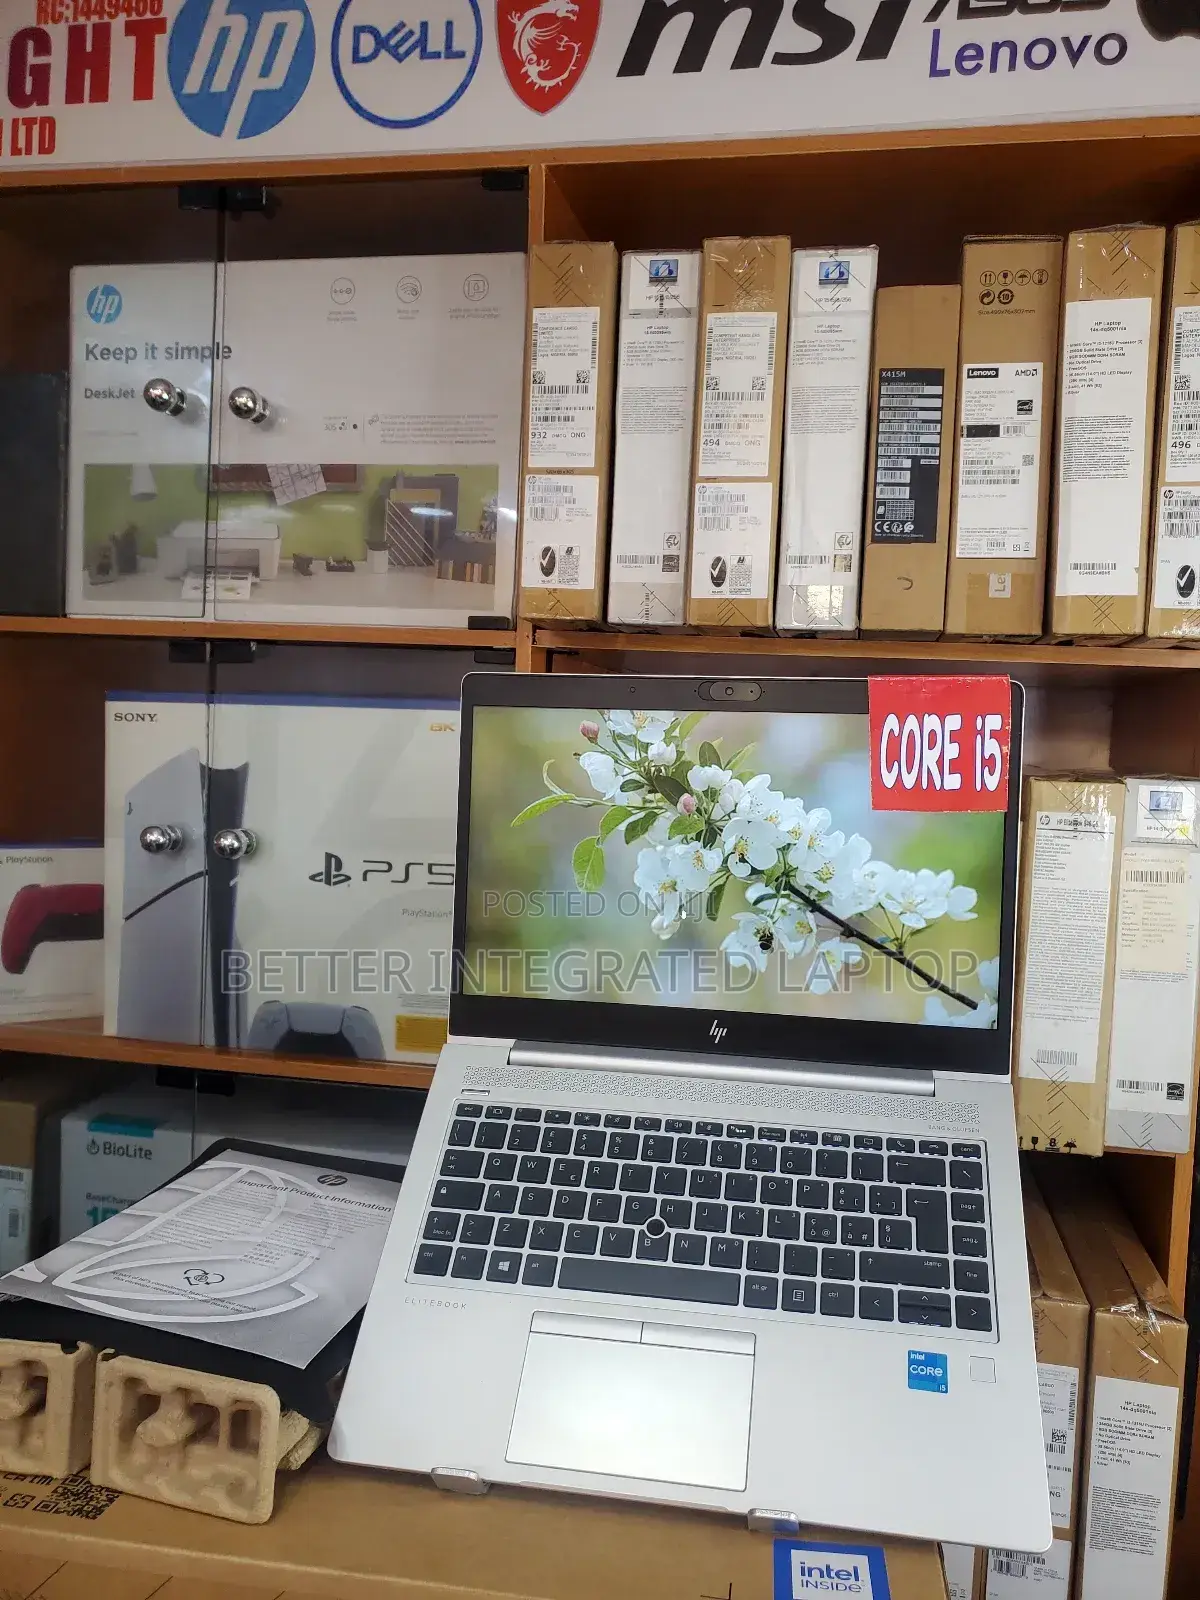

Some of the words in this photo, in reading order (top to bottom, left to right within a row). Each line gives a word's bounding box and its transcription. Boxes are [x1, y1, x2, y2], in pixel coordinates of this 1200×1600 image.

[352, 20, 466, 64] DELL
[929, 28, 1128, 78] Lenovo
[7, 17, 167, 108] GHT
[182, 0, 304, 139] hp
[9, 116, 56, 156] LTD
[90, 285, 119, 324] hp
[85, 343, 138, 364] Keep
[145, 342, 158, 361] it
[164, 341, 233, 363] simple
[881, 370, 907, 378] X415M
[968, 369, 997, 377] Lenovo
[84, 387, 136, 400] DeskJet
[531, 431, 548, 439] 932
[702, 438, 720, 447] 494
[1171, 440, 1191, 449] 496
[113, 712, 158, 723] SONY
[430, 723, 456, 732] 8K
[880, 712, 962, 791] CORE
[975, 713, 1003, 792] i5
[362, 859, 455, 886] PS5
[708, 1019, 728, 1044] hp
[102, 1140, 153, 1161] BioLite
[492, 1158, 501, 1167] Q
[526, 1161, 538, 1169] W
[559, 1163, 567, 1171] E
[592, 1166, 600, 1174] R
[627, 1169, 634, 1177] T
[662, 1172, 670, 1180] Y
[697, 1175, 705, 1183] U
[768, 1182, 777, 1190] O
[803, 1185, 811, 1193] P
[237, 1177, 289, 1193] Important
[289, 1187, 330, 1201] Product
[330, 1195, 393, 1213] Information
[493, 1189, 502, 1198] A
[527, 1192, 535, 1201] S
[561, 1195, 570, 1204] D
[596, 1198, 603, 1207] F
[631, 1201, 640, 1210] G
[666, 1204, 674, 1213] H
[738, 1211, 746, 1220] K
[502, 1223, 511, 1232] Z
[537, 1226, 546, 1235] X
[573, 1230, 581, 1238] C
[609, 1233, 617, 1241] V
[644, 1238, 652, 1247] B
[680, 1240, 689, 1249] N
[717, 1243, 727, 1252] M
[923, 1260, 943, 1268] stamp
[404, 1297, 467, 1310] ELITEBOOK
[800, 1561, 860, 1582] intel
